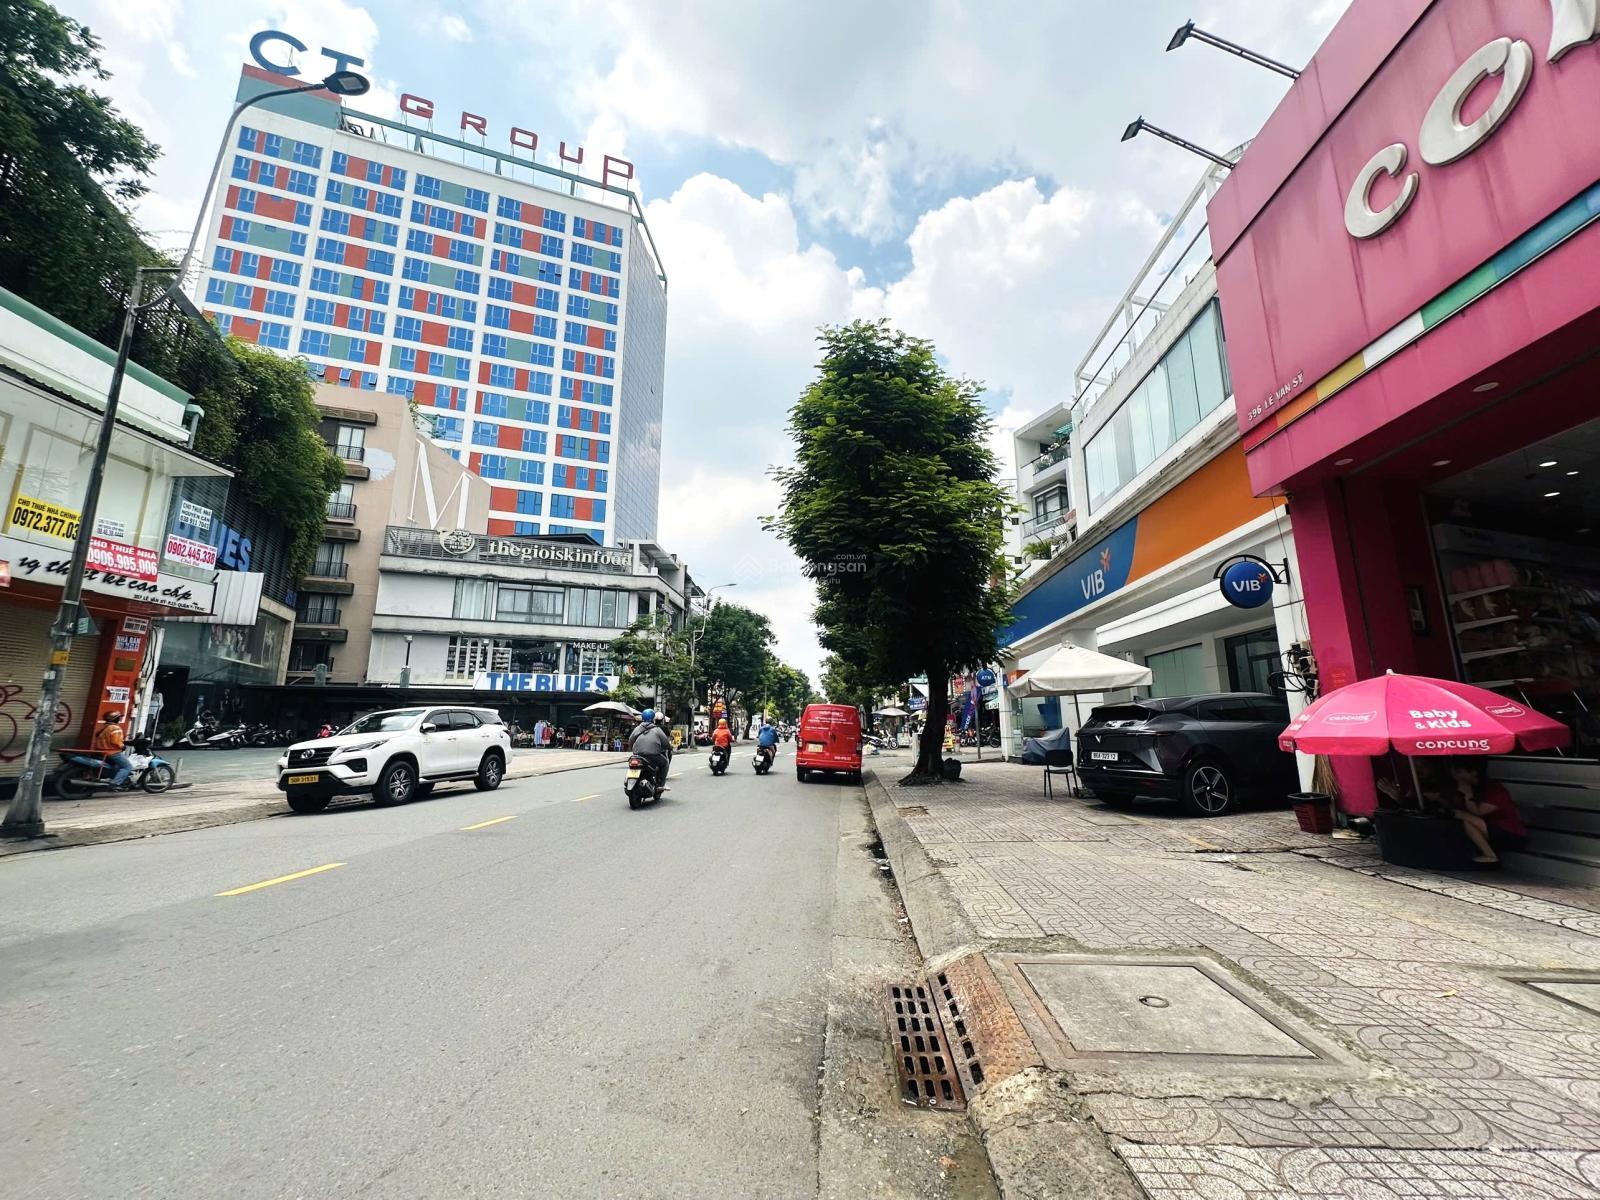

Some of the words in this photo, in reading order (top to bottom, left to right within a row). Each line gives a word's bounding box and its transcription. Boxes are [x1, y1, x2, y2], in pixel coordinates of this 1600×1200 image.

[249, 30, 364, 77] CT
[400, 93, 634, 189] GROUP
[1247, 405, 1262, 421] 396
[12, 506, 80, 540] 0972.377.03
[87, 547, 158, 576] 0906.905.006
[489, 540, 632, 566] thegioiskinfood
[1081, 569, 1105, 600] VIB
[1232, 580, 1261, 592] VIB
[573, 642, 597, 650] MAKE
[487, 672, 533, 690] THE
[1408, 709, 1458, 719] Baby
[1427, 719, 1472, 729] Kids
[1415, 739, 1490, 751] concung
